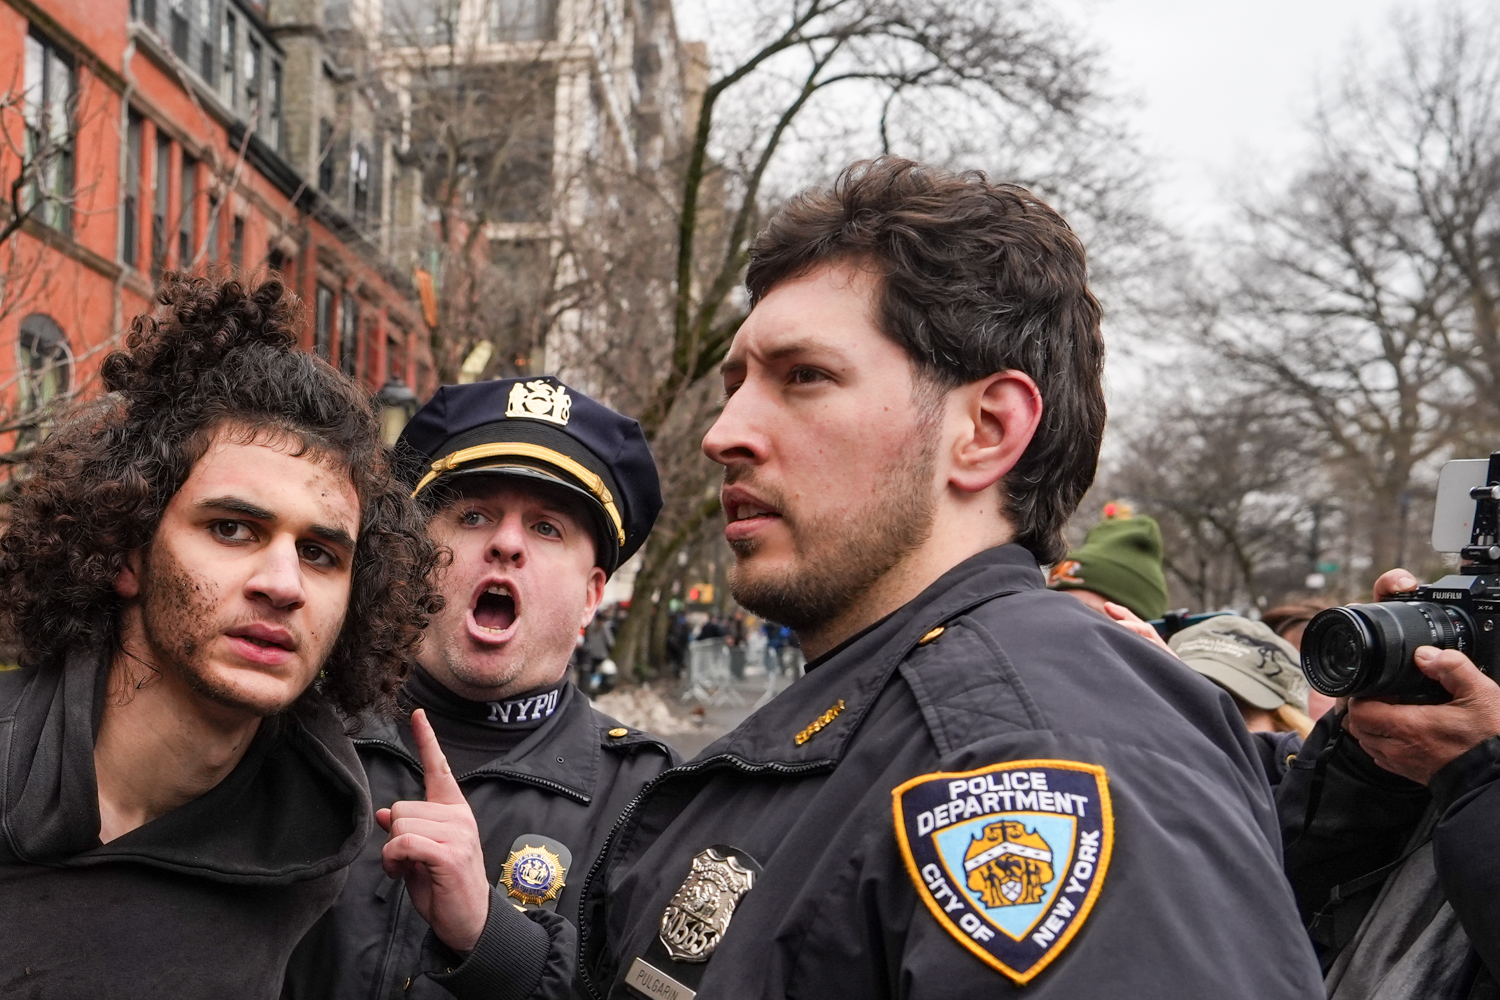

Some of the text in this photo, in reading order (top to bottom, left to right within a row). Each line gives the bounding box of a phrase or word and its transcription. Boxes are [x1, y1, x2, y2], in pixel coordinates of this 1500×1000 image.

[1431, 591, 1463, 600] FUJIFILM
[487, 689, 559, 723] NYPD
[948, 772, 1049, 799] POLICE
[917, 790, 1088, 837] DEPARTMENT
[921, 863, 995, 942] CITY OF
[1032, 830, 1100, 949] NEW YORK
